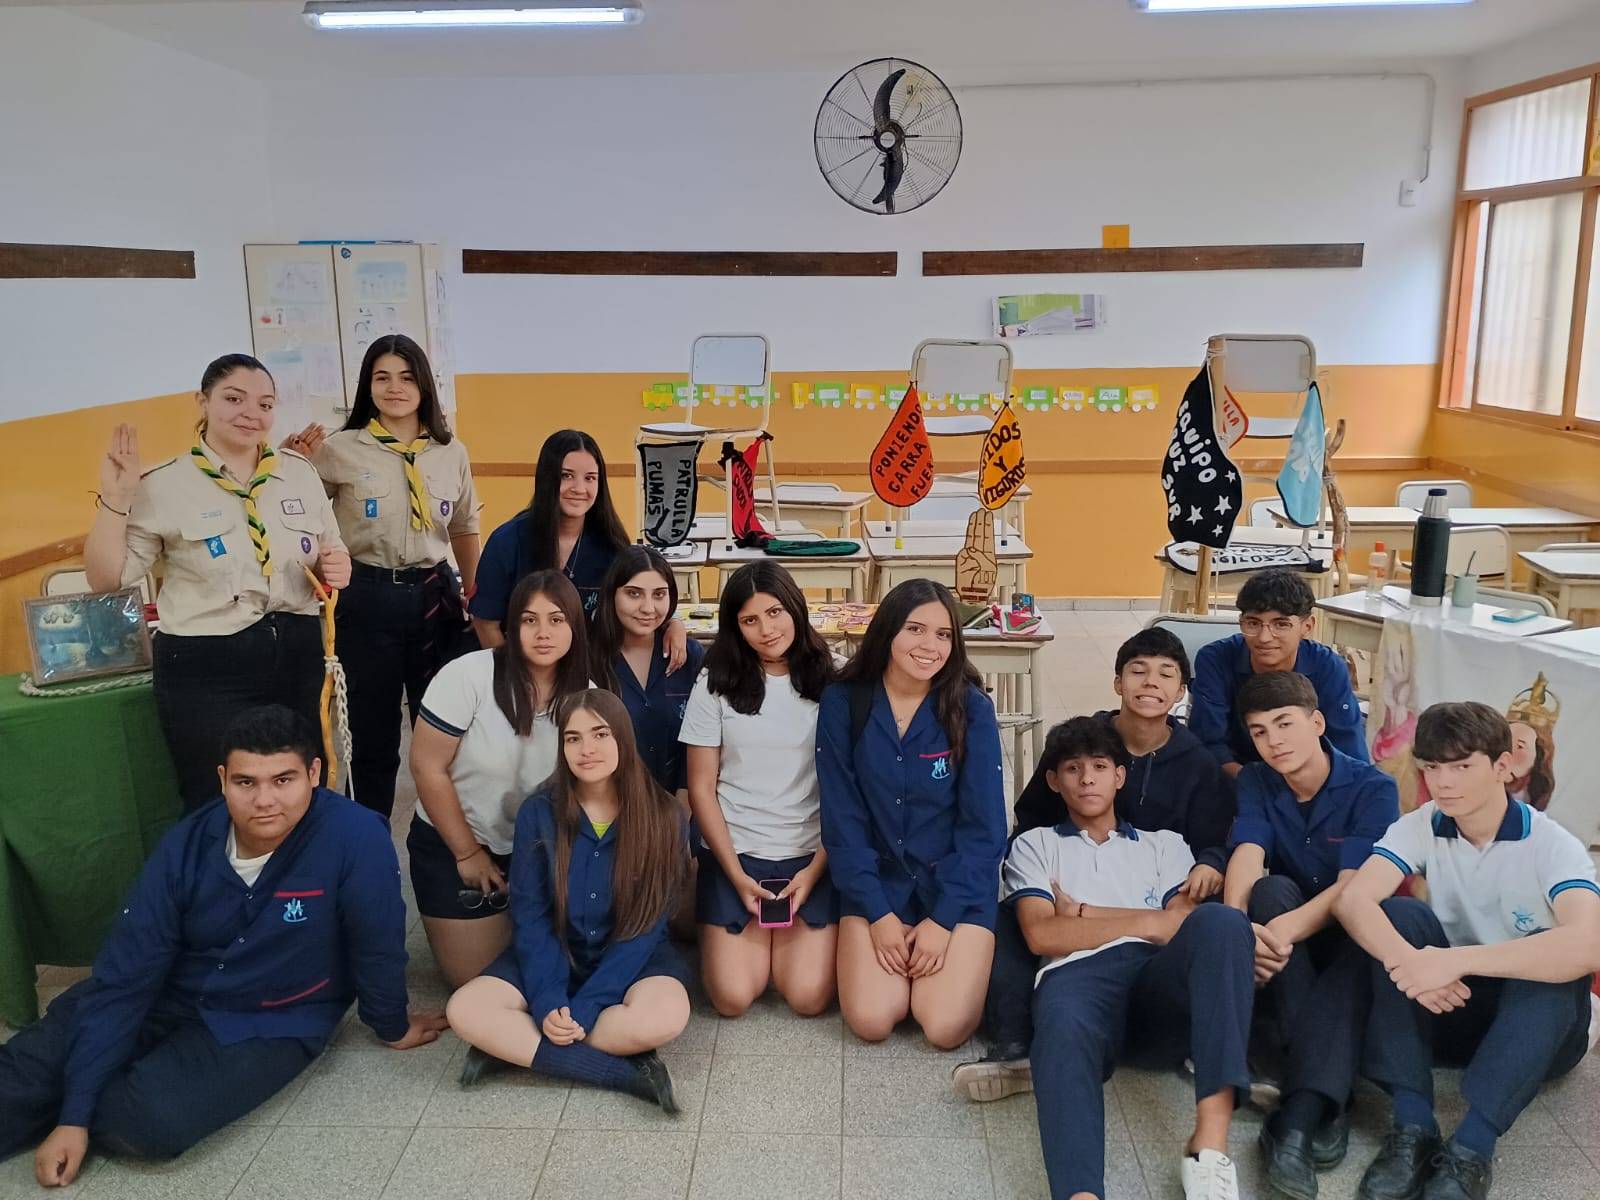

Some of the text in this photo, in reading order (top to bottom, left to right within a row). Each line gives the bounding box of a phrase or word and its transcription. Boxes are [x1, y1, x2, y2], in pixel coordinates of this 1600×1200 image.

[875, 403, 923, 477] PONIENDO
[981, 421, 1021, 474] IDOS
[993, 456, 1008, 473] Y
[647, 461, 665, 516] PUMAS
[671, 459, 692, 538] PATRULLA
